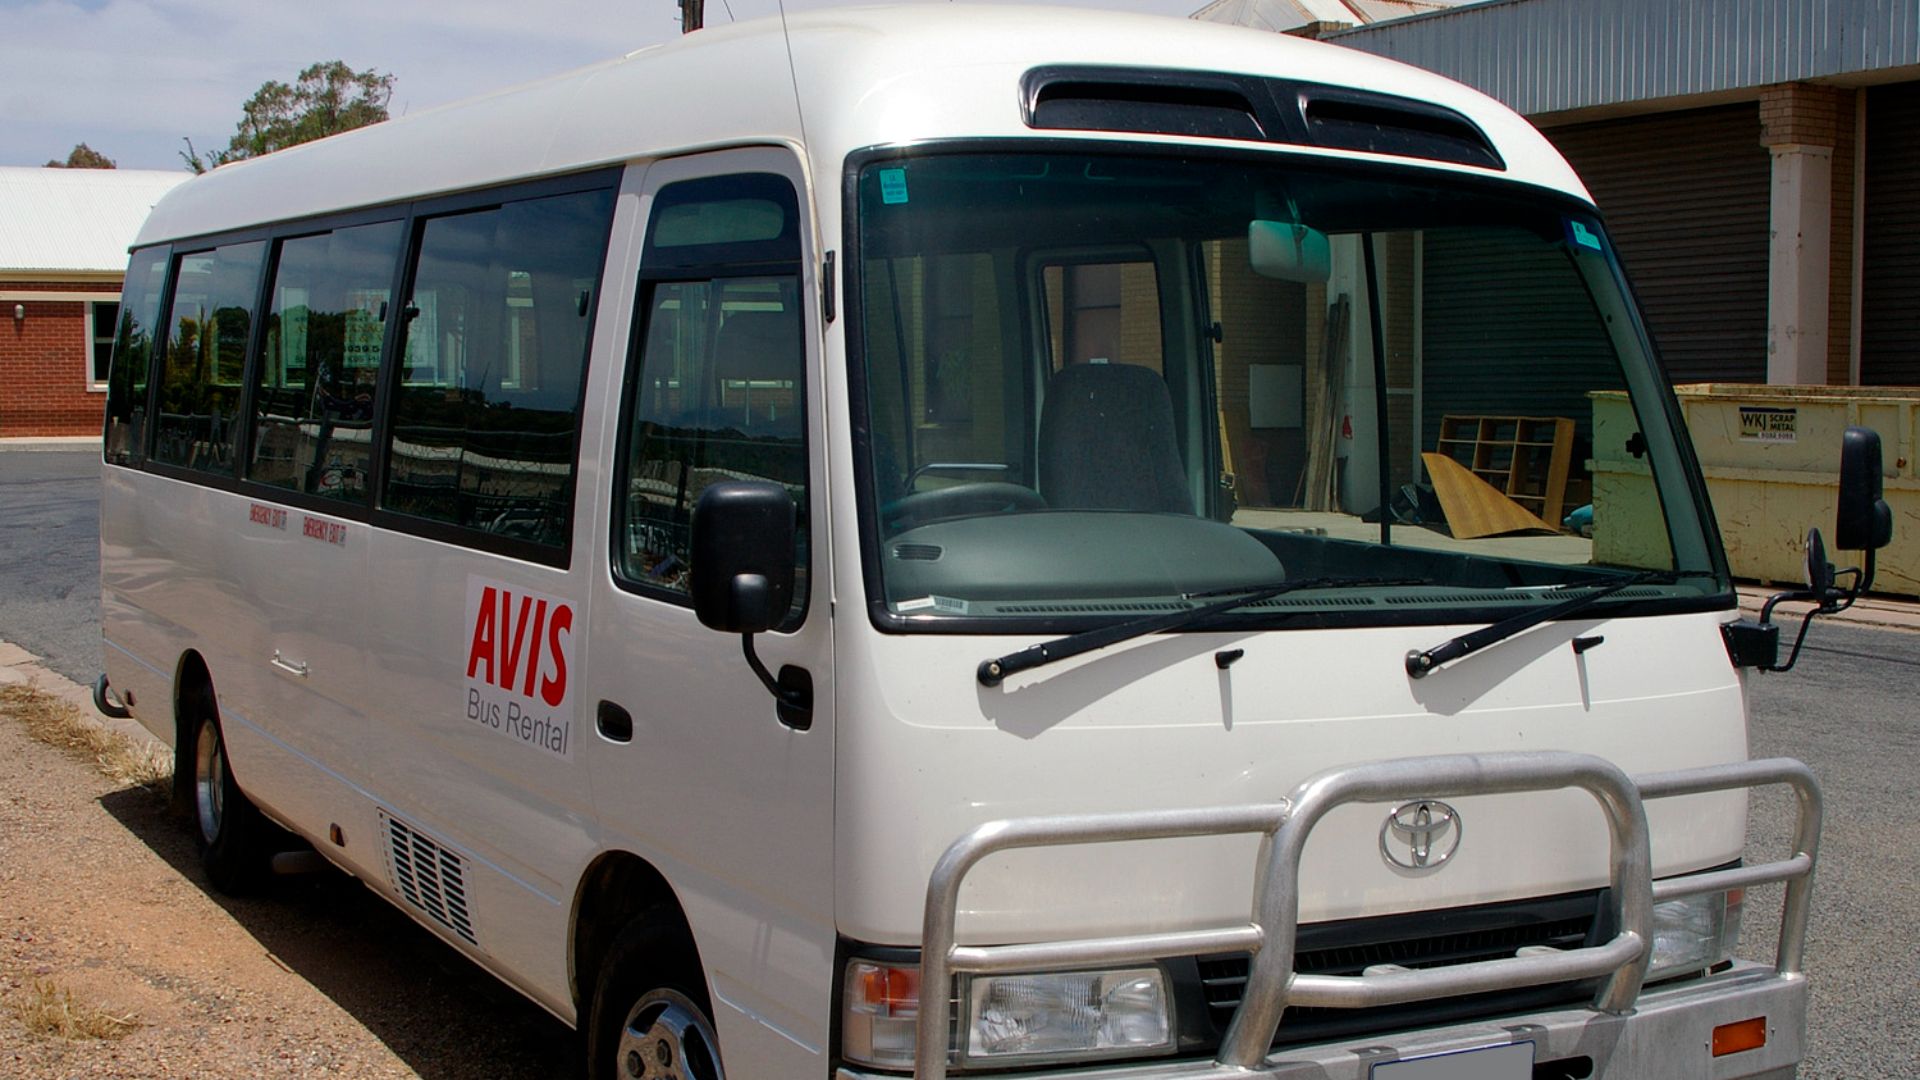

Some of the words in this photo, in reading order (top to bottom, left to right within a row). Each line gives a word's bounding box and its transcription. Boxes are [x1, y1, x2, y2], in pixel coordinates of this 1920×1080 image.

[1741, 413, 1767, 431] WKJ
[1769, 414, 1796, 423] SCRAP
[1770, 423, 1795, 432] METAL
[304, 515, 329, 542] EMERGENCY
[466, 586, 573, 707] AVIS
[467, 687, 500, 729] Bus
[506, 701, 569, 755] Rental
